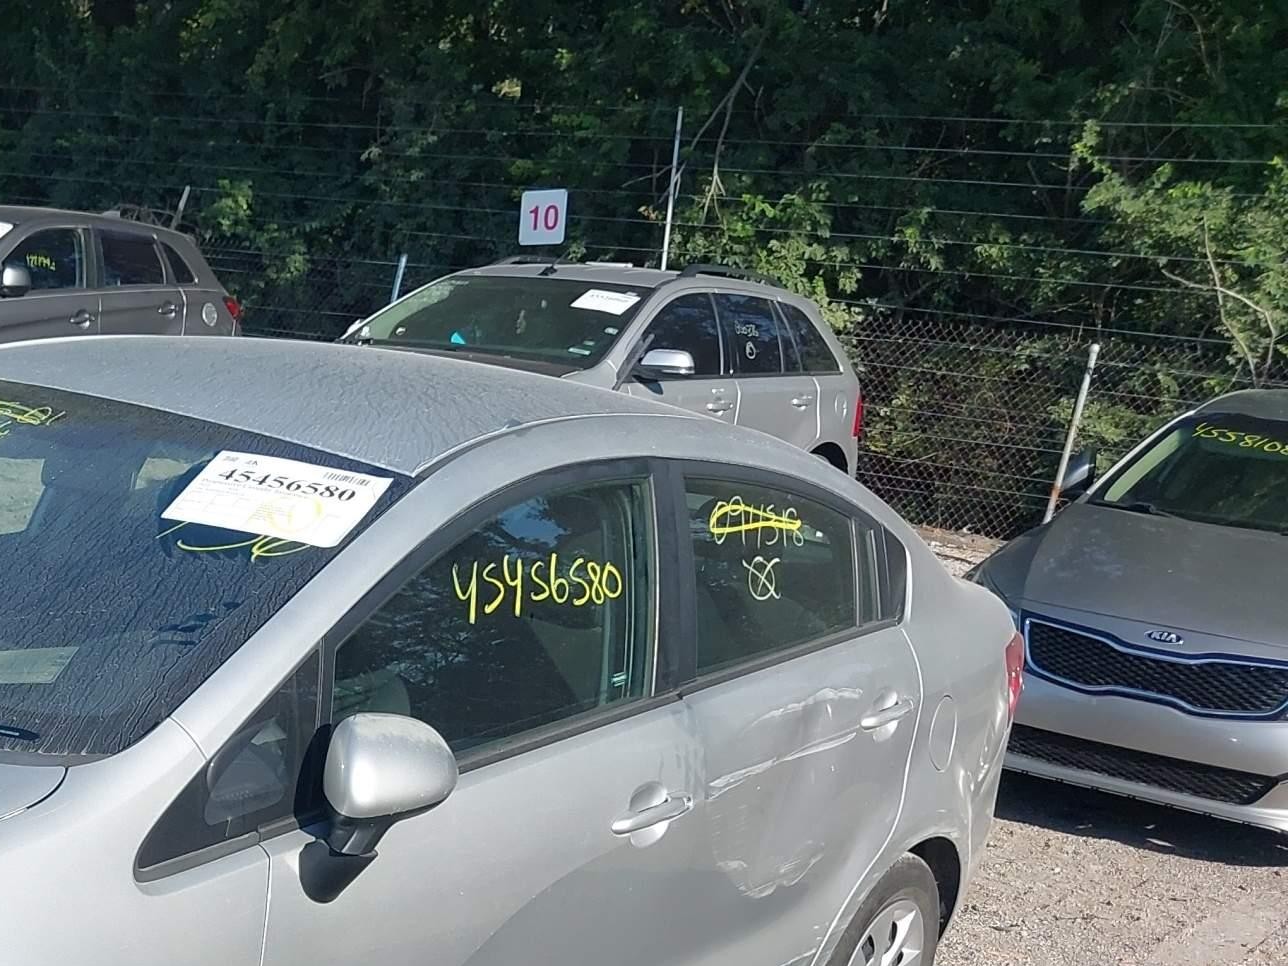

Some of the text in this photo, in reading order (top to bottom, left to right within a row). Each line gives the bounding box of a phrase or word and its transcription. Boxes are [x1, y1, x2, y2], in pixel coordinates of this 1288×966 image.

[529, 205, 559, 231] 10
[218, 468, 357, 502] 45456580
[452, 553, 622, 625] 45456580
[1150, 631, 1178, 643] KIA
